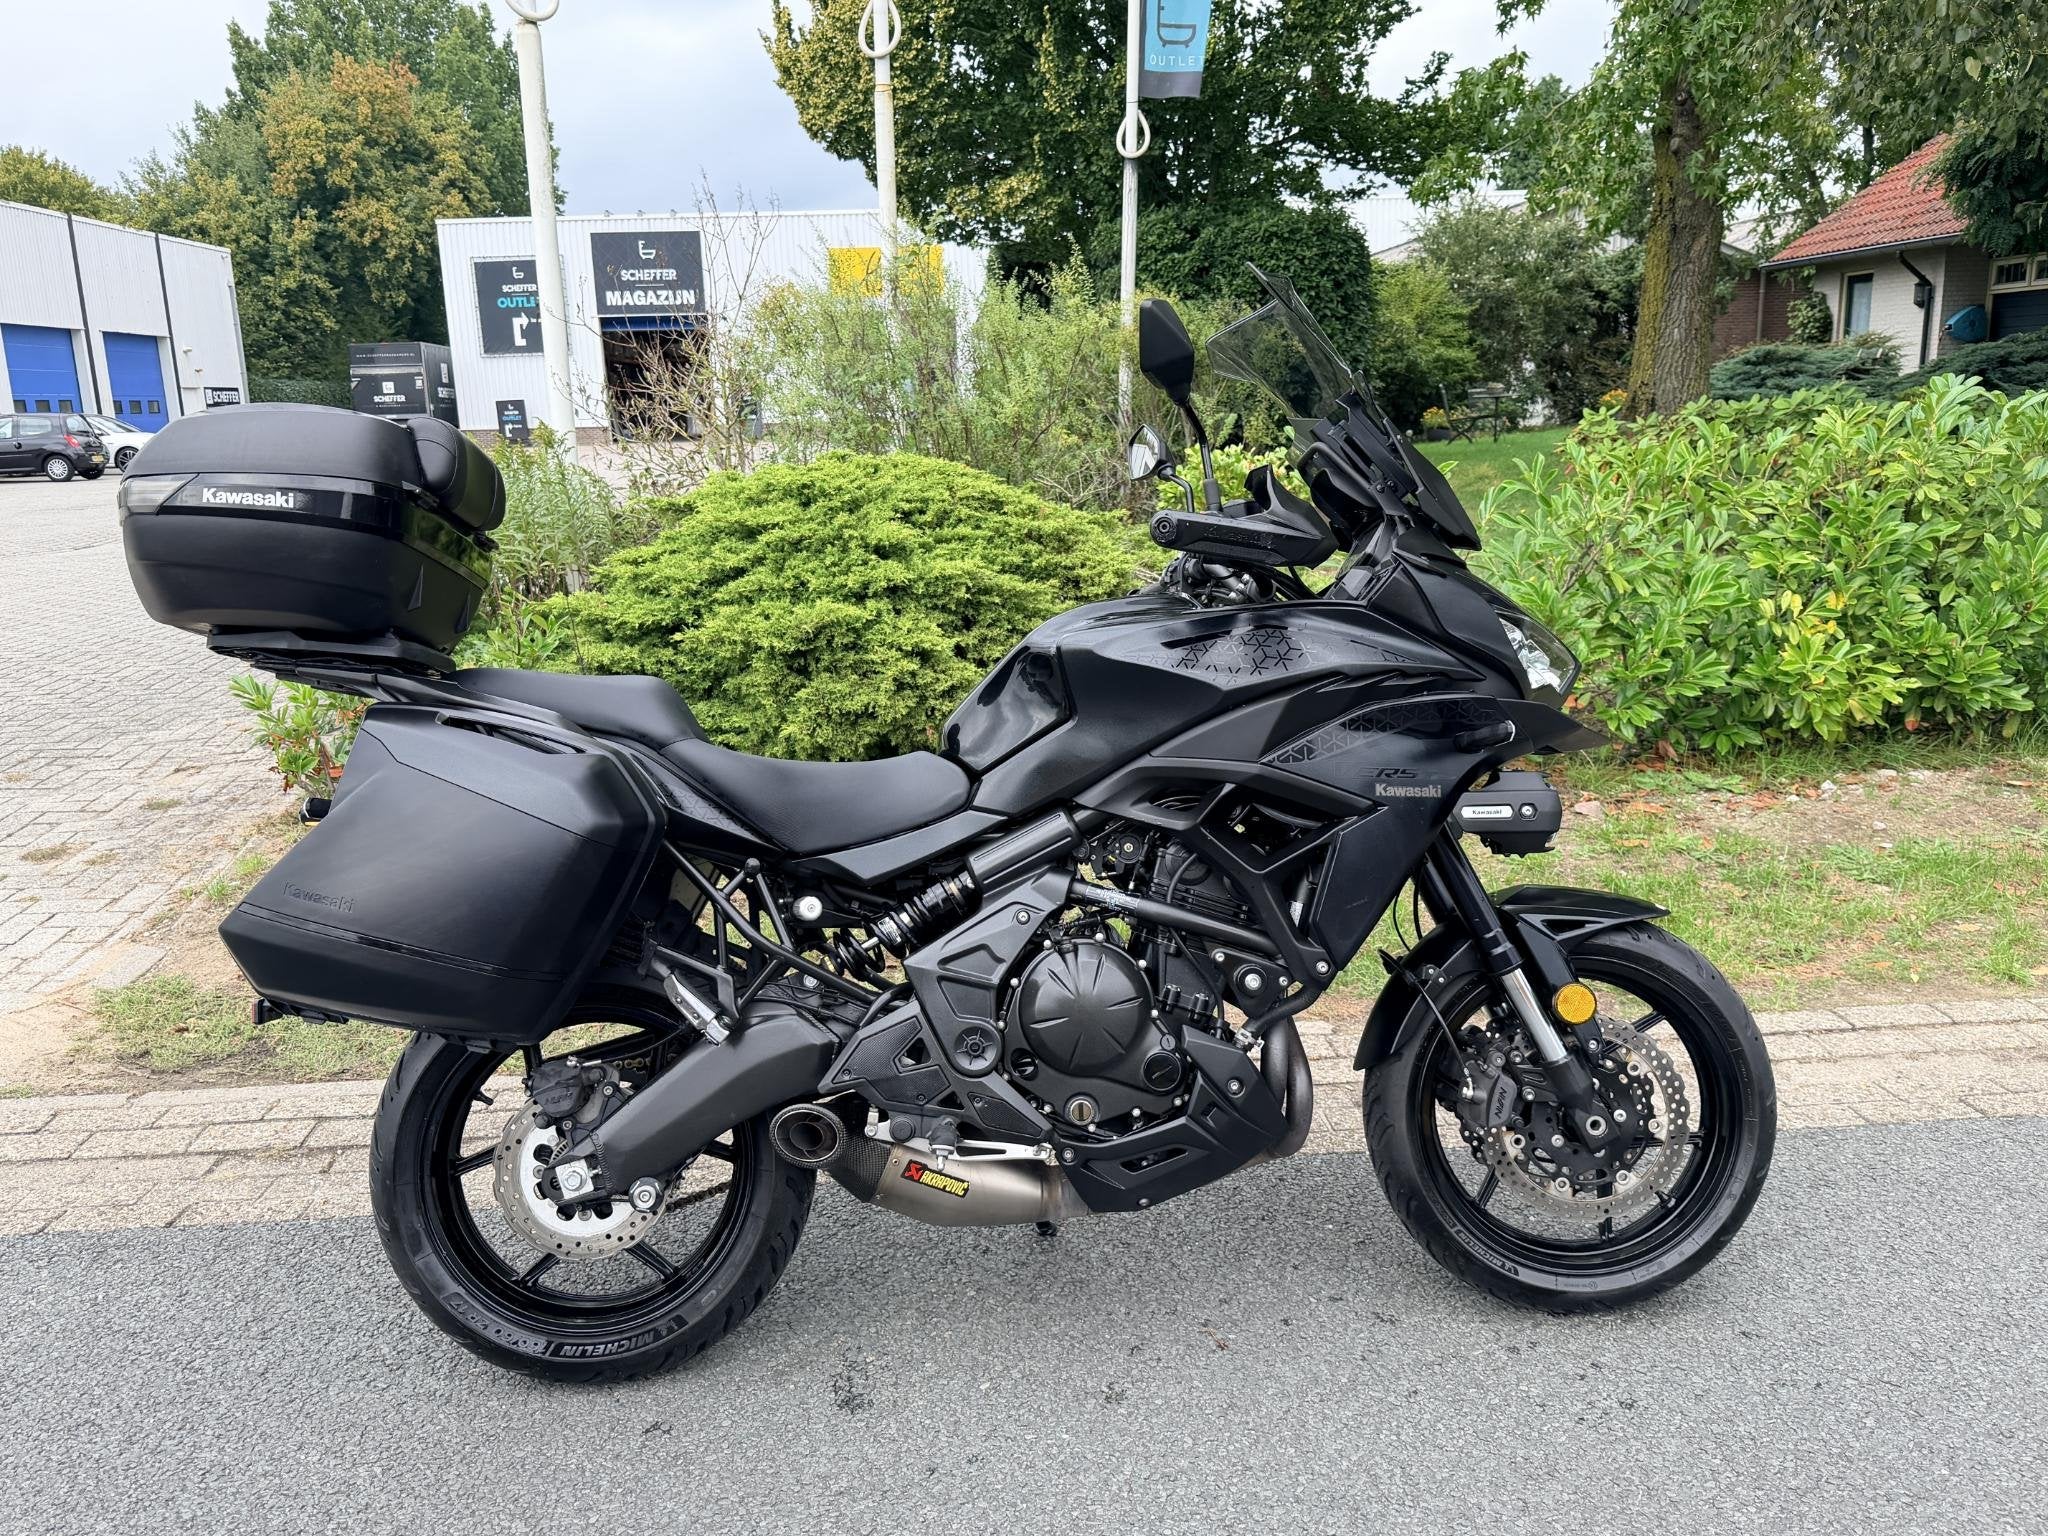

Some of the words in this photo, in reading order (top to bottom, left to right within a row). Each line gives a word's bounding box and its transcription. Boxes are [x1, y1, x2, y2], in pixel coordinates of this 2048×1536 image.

[620, 268, 677, 281] SCHEFFER
[501, 283, 538, 293] SCHEFFER
[605, 289, 695, 306] MAGAZIJN
[213, 391, 240, 403] SCHEFFER
[373, 394, 407, 403] SCHEFFER
[202, 487, 295, 508] Kawasaki
[1375, 783, 1442, 798] Kawasaki
[1471, 808, 1503, 816] Kawasaki
[282, 880, 356, 913] Kawasaki
[559, 1330, 655, 1357] MICHELIN
